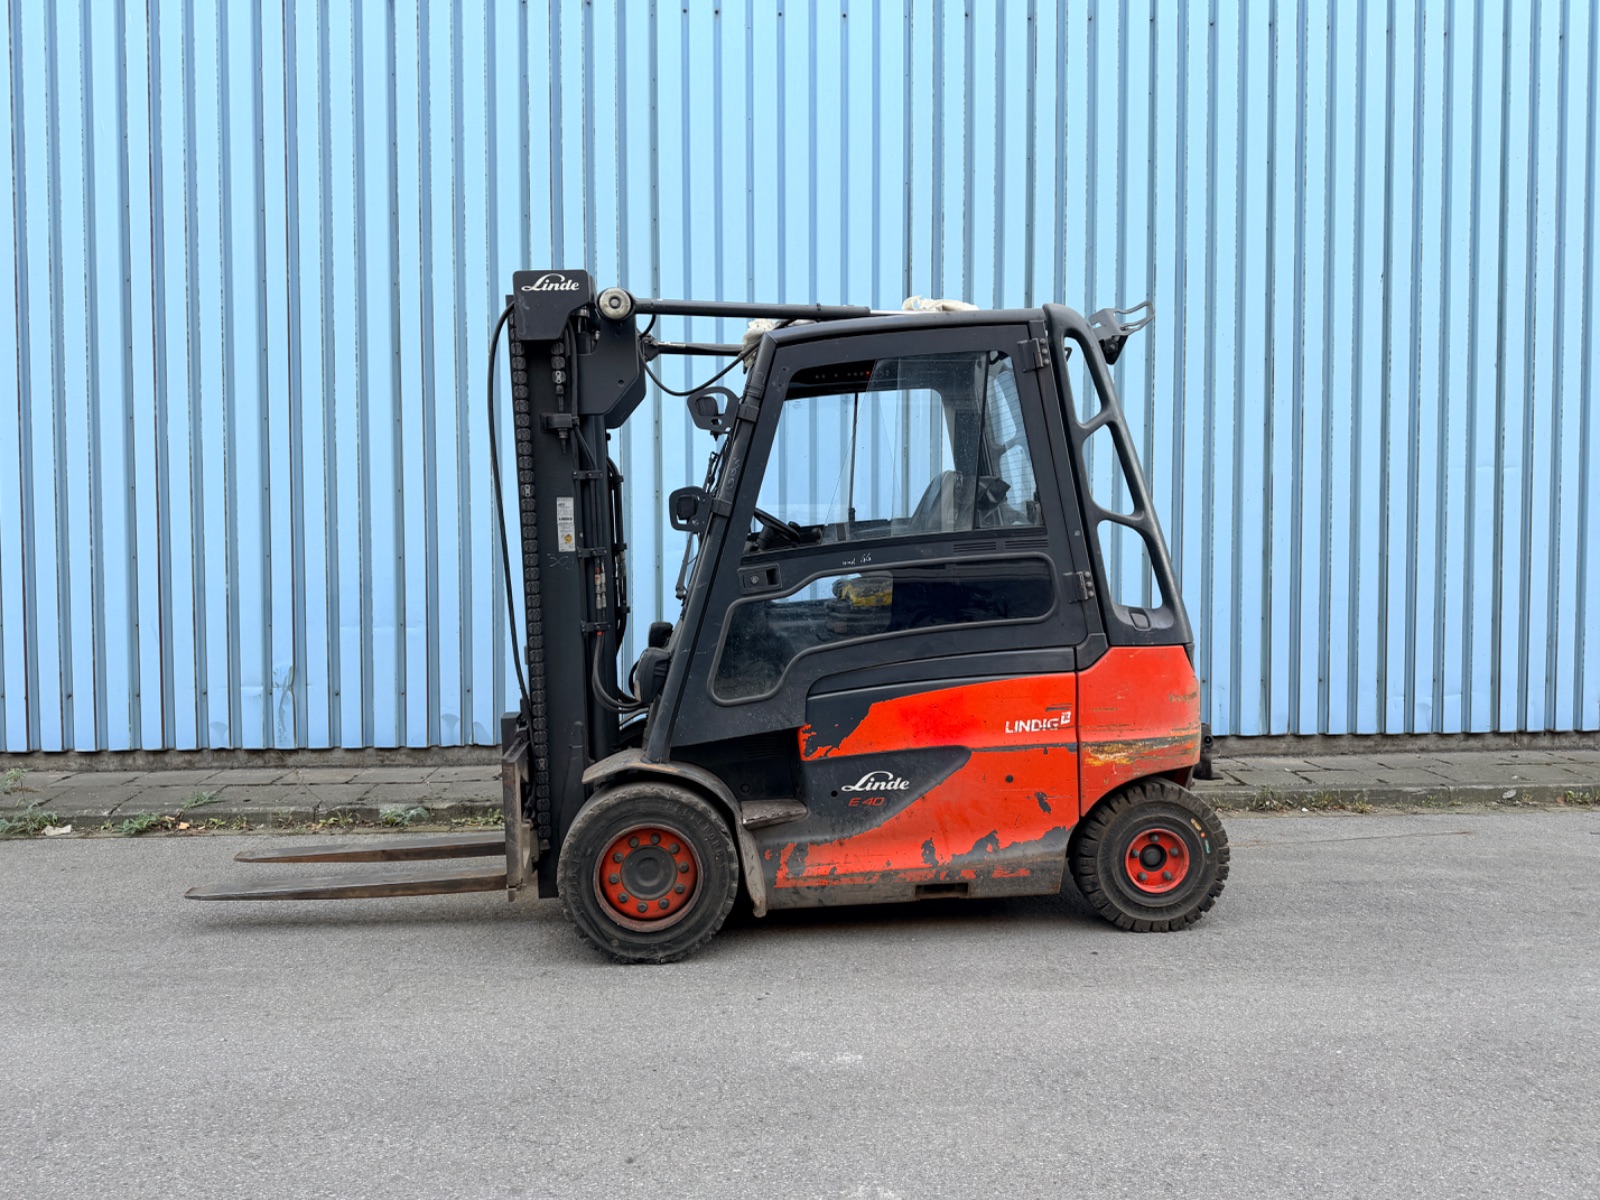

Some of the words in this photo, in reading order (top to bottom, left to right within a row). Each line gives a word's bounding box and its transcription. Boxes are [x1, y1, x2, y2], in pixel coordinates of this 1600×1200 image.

[521, 273, 580, 292] Linde
[1005, 718, 1060, 734] LINDIG
[841, 770, 910, 792] Linde
[848, 797, 861, 807] E
[862, 797, 885, 807] 40
